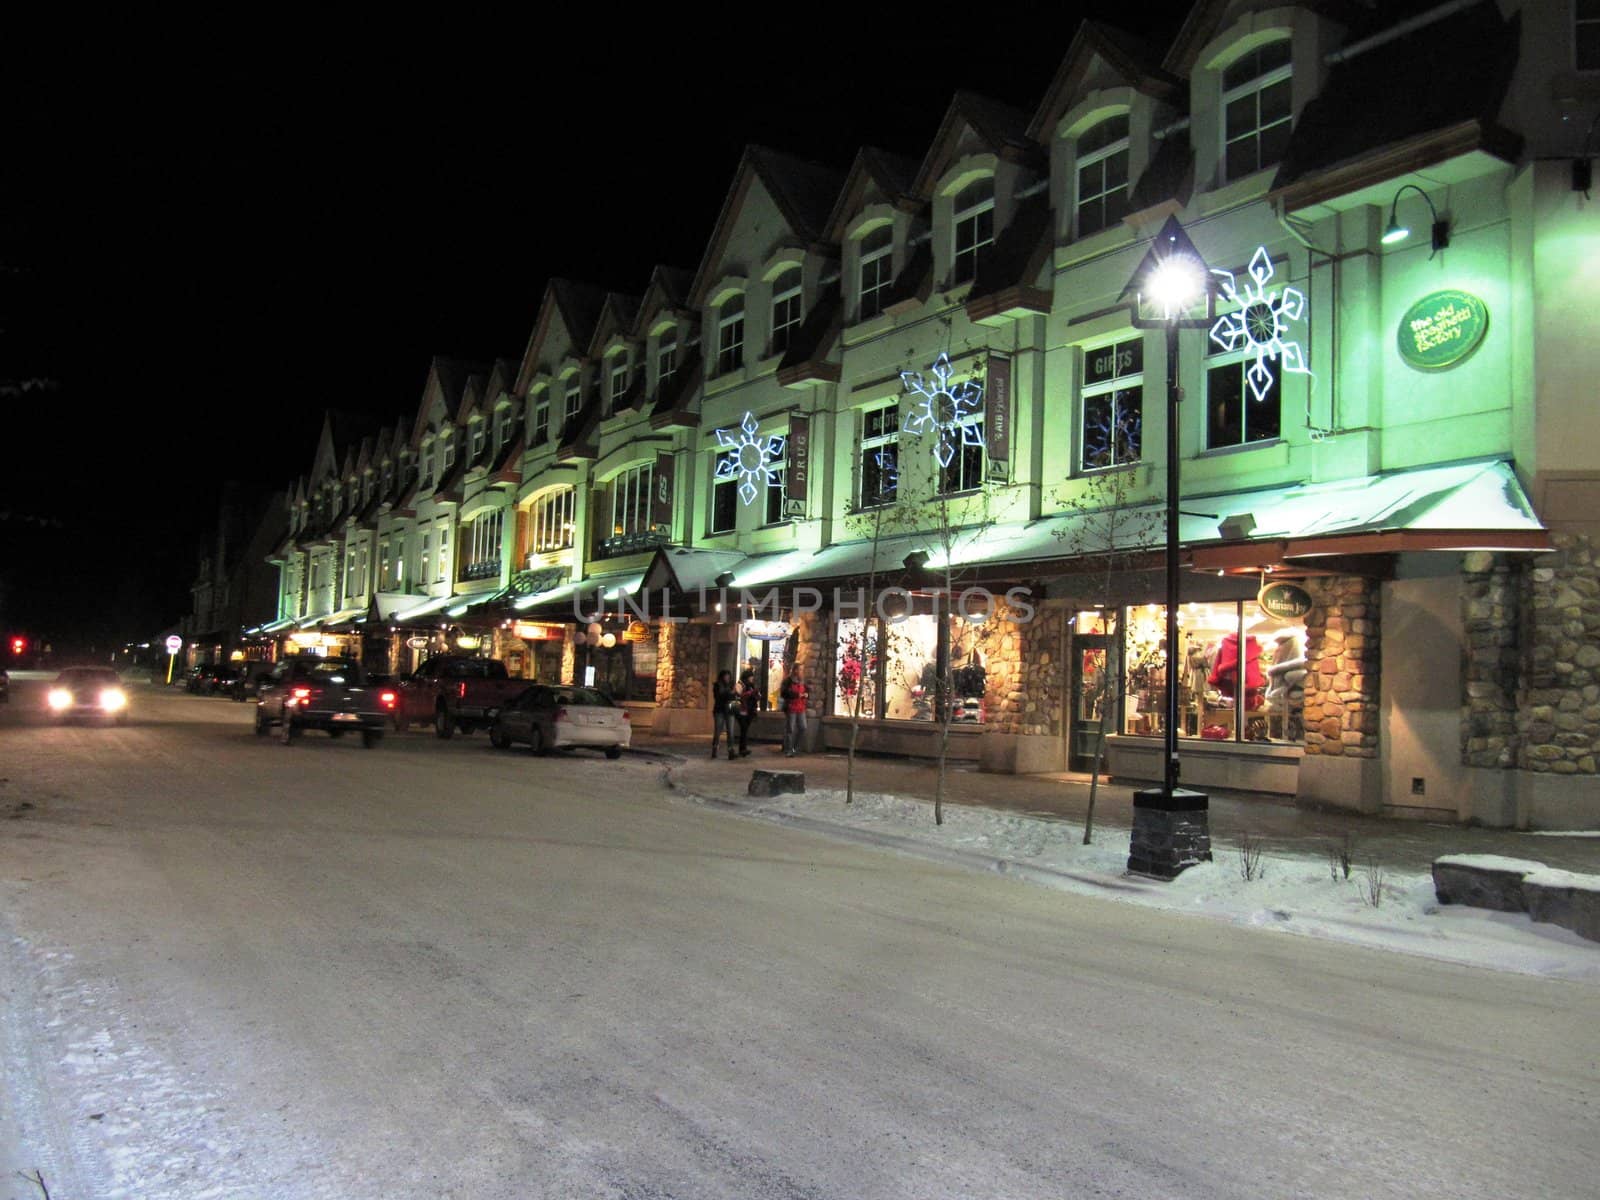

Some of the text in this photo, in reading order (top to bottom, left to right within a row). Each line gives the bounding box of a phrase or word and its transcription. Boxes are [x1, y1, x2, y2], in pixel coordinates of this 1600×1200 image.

[1410, 302, 1455, 332] the old
[1095, 350, 1133, 374] GIFTS
[796, 436, 806, 481] DRUG
